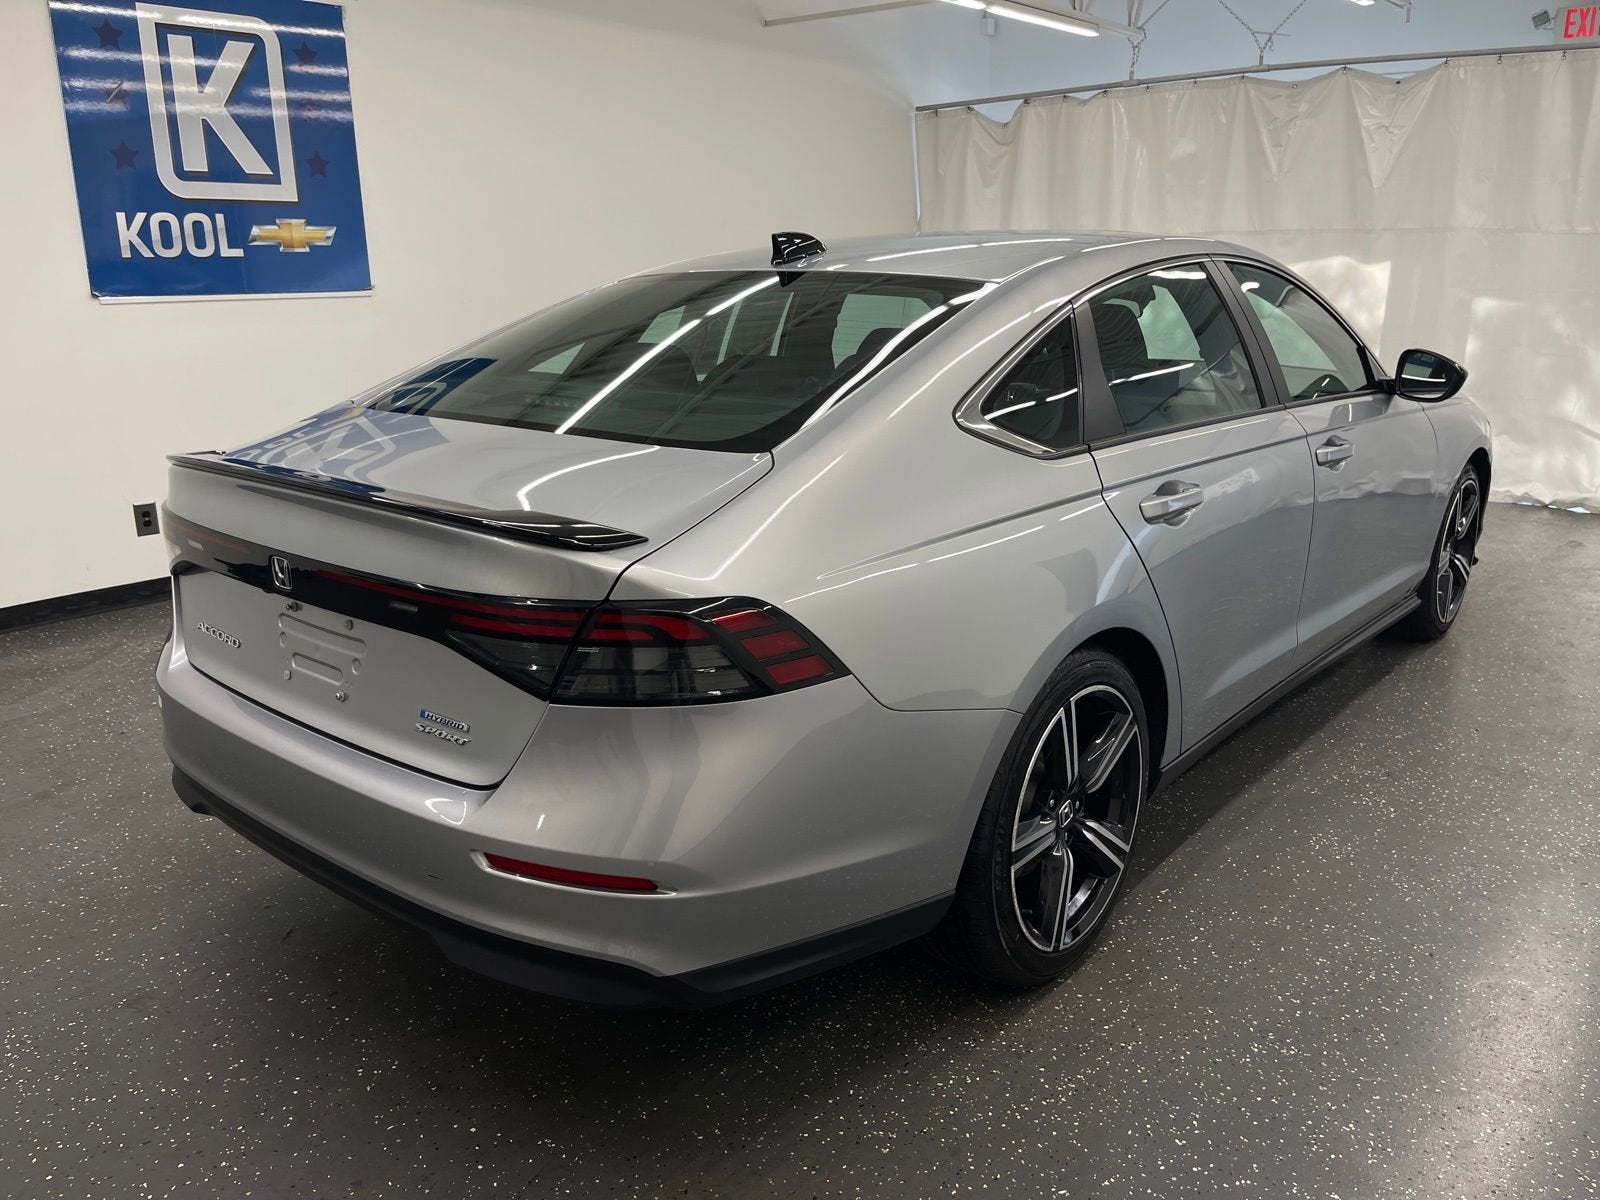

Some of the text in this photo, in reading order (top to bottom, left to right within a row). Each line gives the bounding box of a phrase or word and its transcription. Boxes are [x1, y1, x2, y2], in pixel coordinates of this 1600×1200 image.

[1563, 7, 1600, 38] EXI
[167, 35, 273, 175] K
[115, 212, 245, 258] KOOL
[197, 621, 241, 648] ACCORD
[415, 722, 472, 746] SPORT
[425, 711, 466, 731] HYBRID
